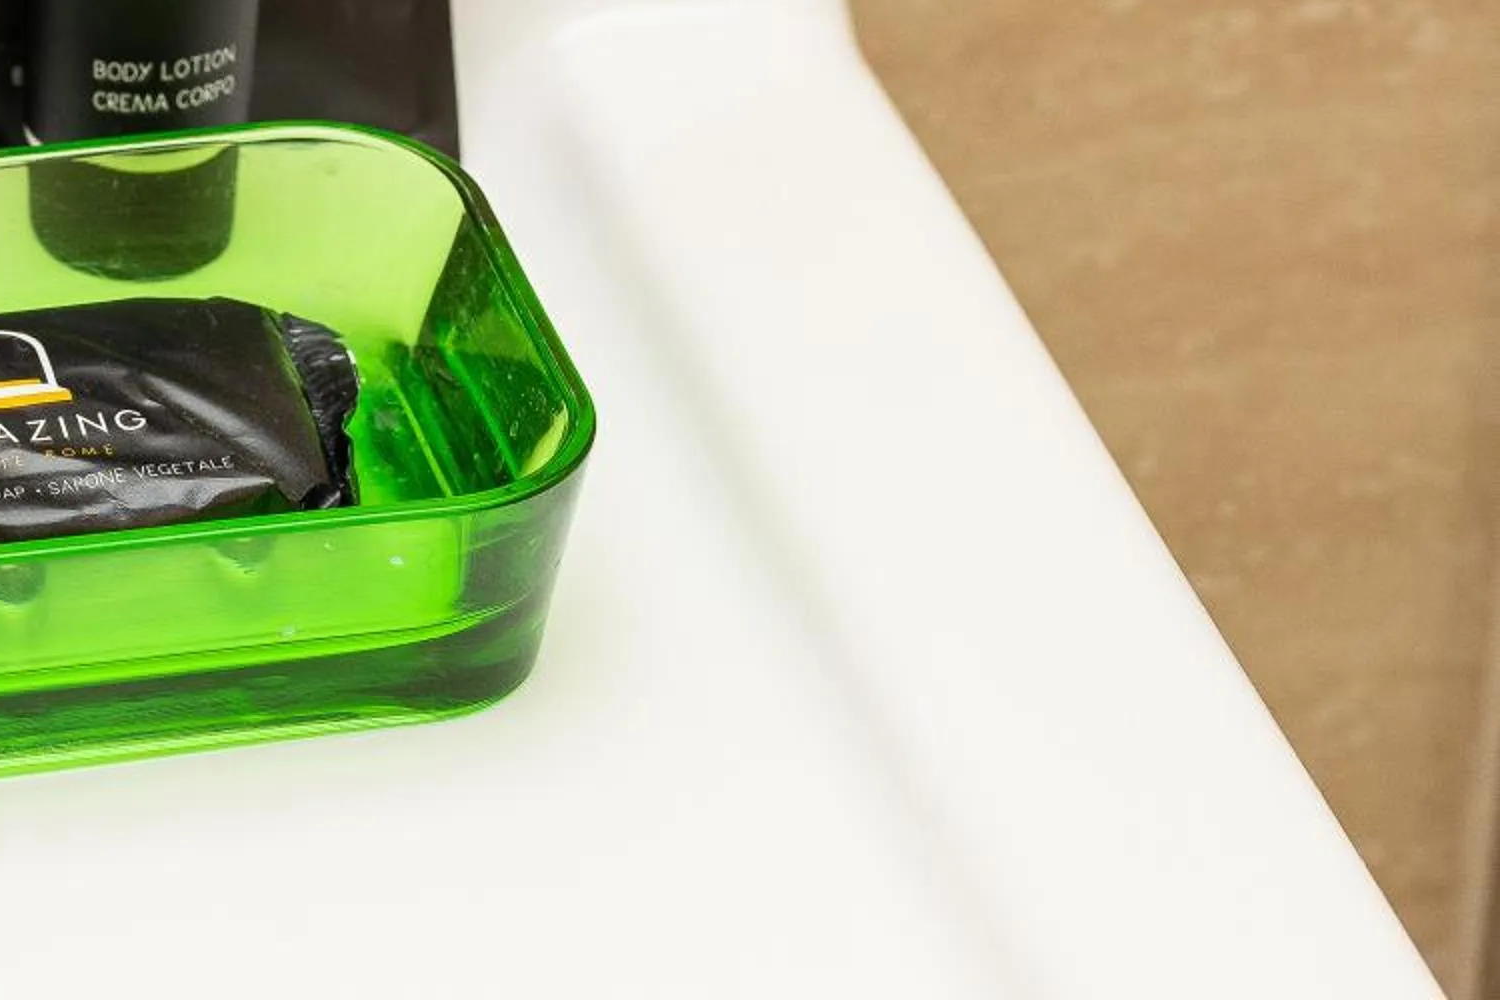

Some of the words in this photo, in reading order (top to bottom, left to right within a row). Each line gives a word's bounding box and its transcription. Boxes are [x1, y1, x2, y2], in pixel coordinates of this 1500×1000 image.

[92, 59, 153, 83] BODY
[160, 43, 238, 81] LOTION
[92, 90, 170, 113] CREMA
[175, 75, 236, 110] CORPO
[47, 467, 126, 497] SAPONE
[132, 455, 235, 480] VEGETALE
